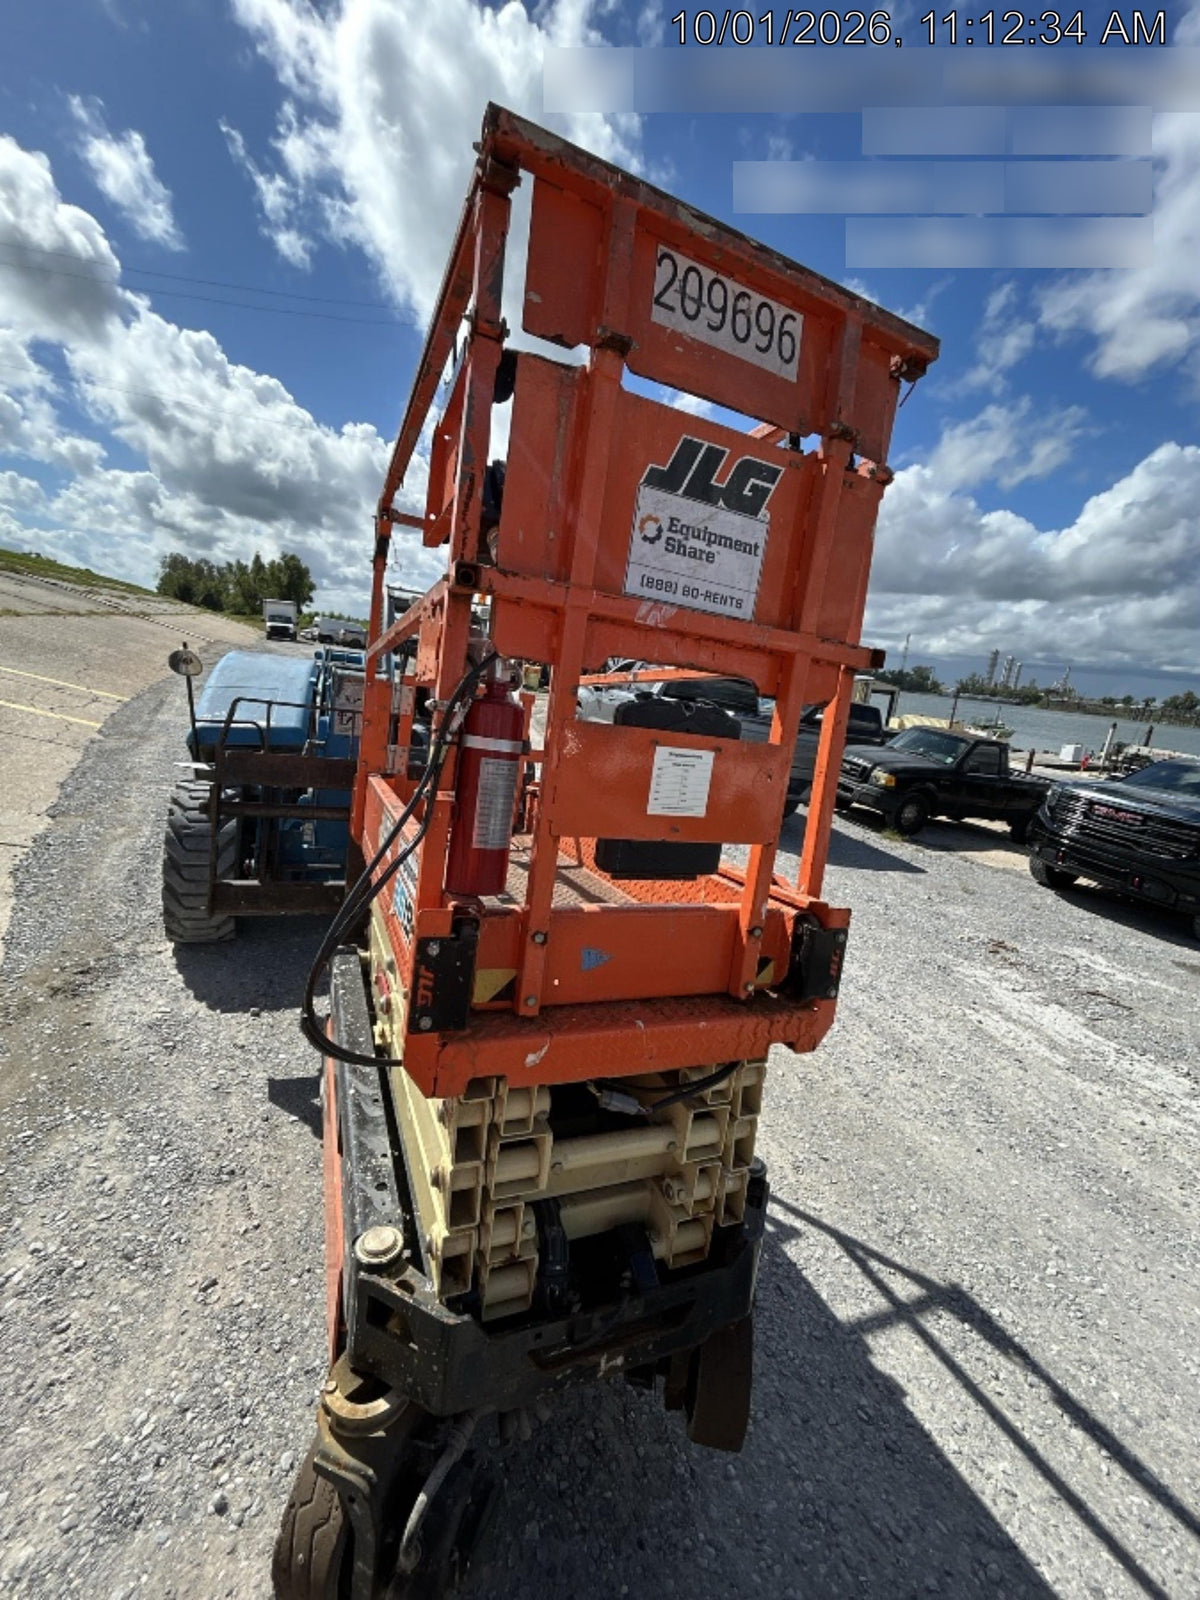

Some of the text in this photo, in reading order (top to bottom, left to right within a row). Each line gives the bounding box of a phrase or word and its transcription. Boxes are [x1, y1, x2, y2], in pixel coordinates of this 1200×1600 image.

[653, 251, 799, 365] 209696
[639, 434, 785, 519] JLG
[664, 536, 717, 564] Share
[666, 516, 760, 558] Equipment
[640, 573, 679, 595] (888)
[416, 964, 435, 1009] JLG
